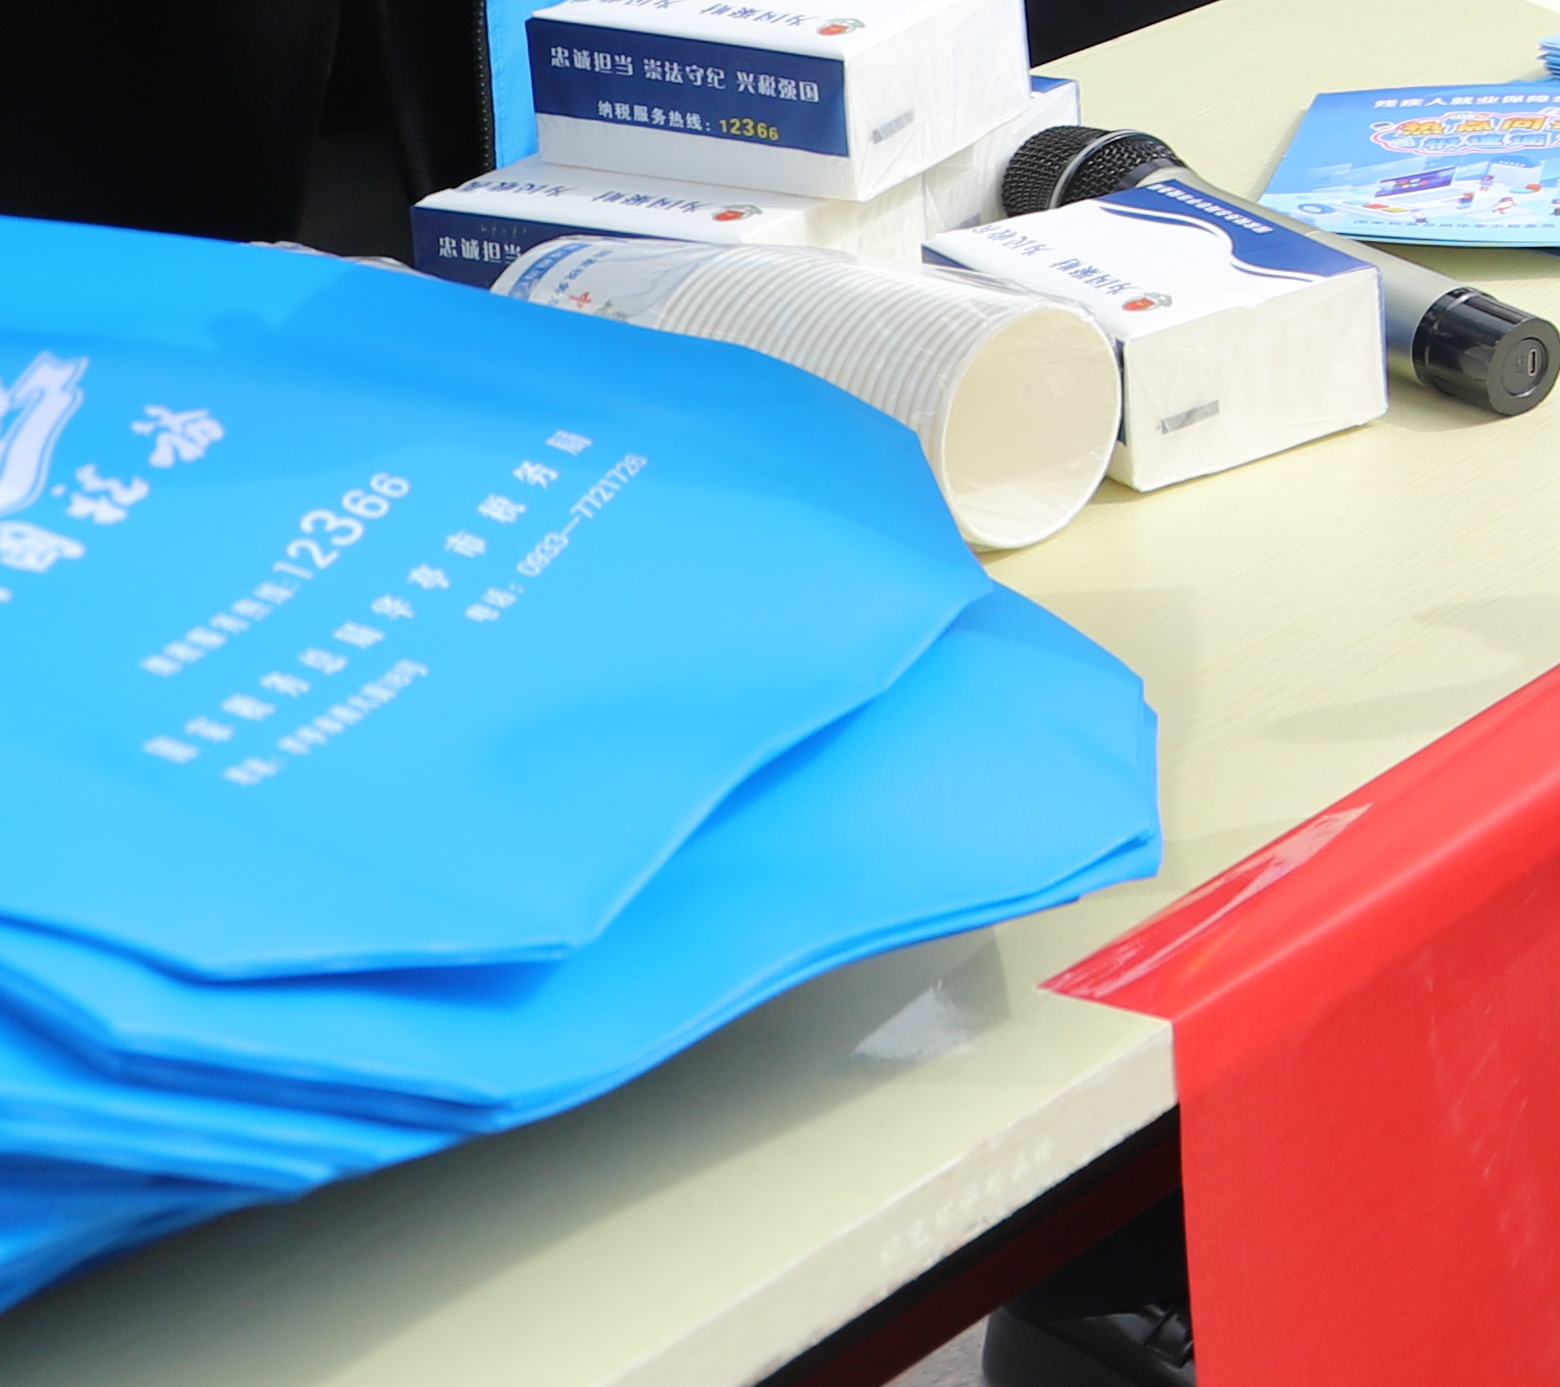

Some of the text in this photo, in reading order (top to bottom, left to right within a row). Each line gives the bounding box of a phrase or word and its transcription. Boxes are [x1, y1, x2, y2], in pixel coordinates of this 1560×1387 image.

[549, 44, 821, 105] 忠诚担当 崇法守纪 兴税强国
[717, 116, 780, 144] 12366
[438, 235, 522, 266] 忠诚担当
